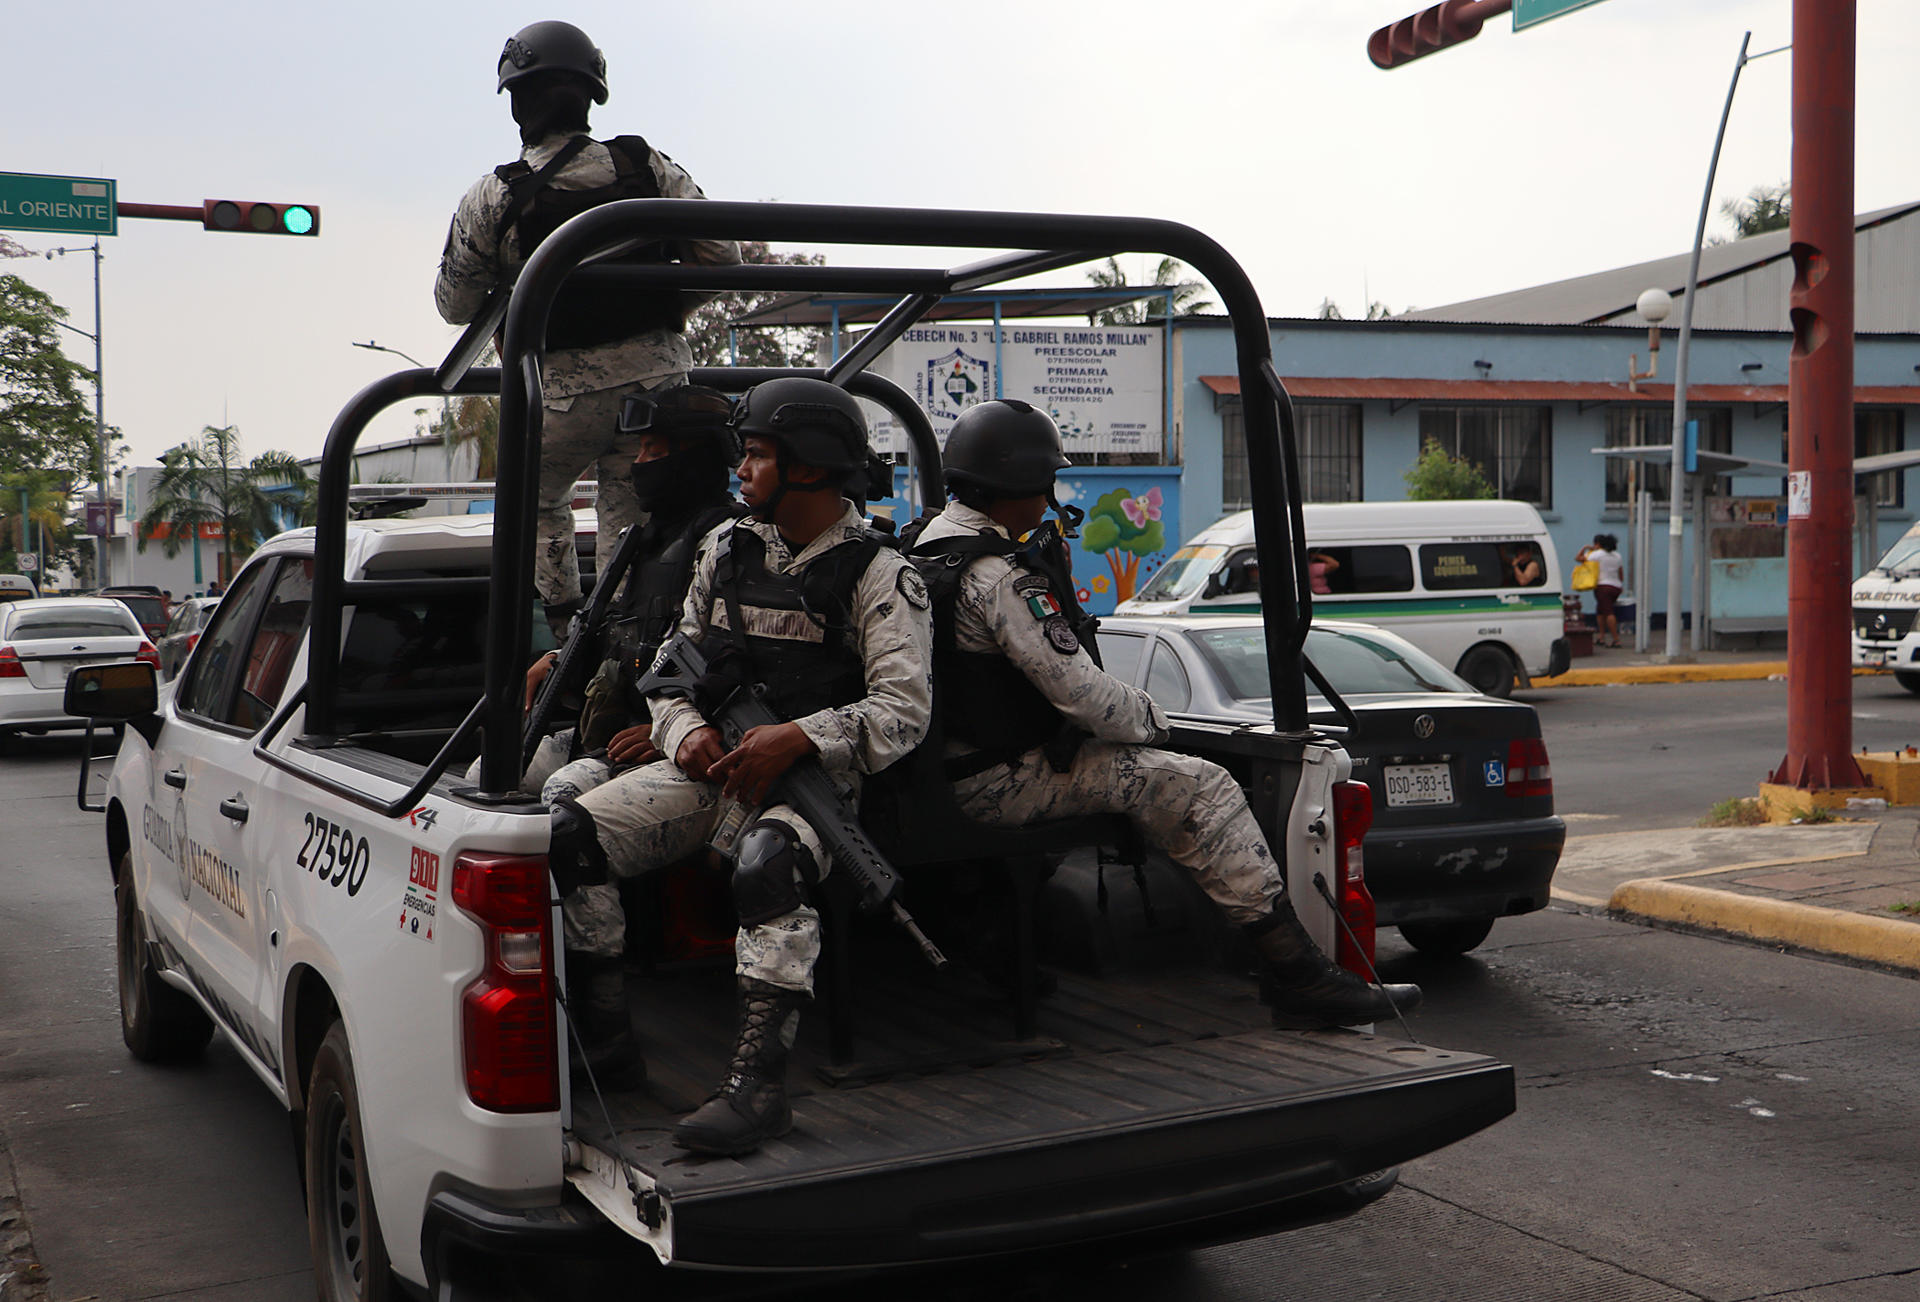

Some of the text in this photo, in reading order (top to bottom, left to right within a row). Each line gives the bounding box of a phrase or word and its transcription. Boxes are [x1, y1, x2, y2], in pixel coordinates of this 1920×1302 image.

[0, 200, 108, 220] L ORIENTE
[902, 330, 945, 342] CEBECH
[950, 330, 968, 343] No.
[971, 331, 978, 343] 3
[984, 331, 1010, 344] "LC.
[1014, 331, 1059, 345] GABRIEL
[1064, 332, 1103, 345] RAMOS
[1035, 347, 1117, 357] PREESCOLAR
[1047, 367, 1108, 376] PRIMARIA
[1033, 386, 1114, 395] SECUNDARIA
[1388, 775, 1450, 794] DSD-583-E
[296, 812, 370, 897] 27590
[410, 848, 438, 889] 911
[190, 839, 245, 919] NACIONAL
[403, 893, 435, 917] EMERGENCIAS
